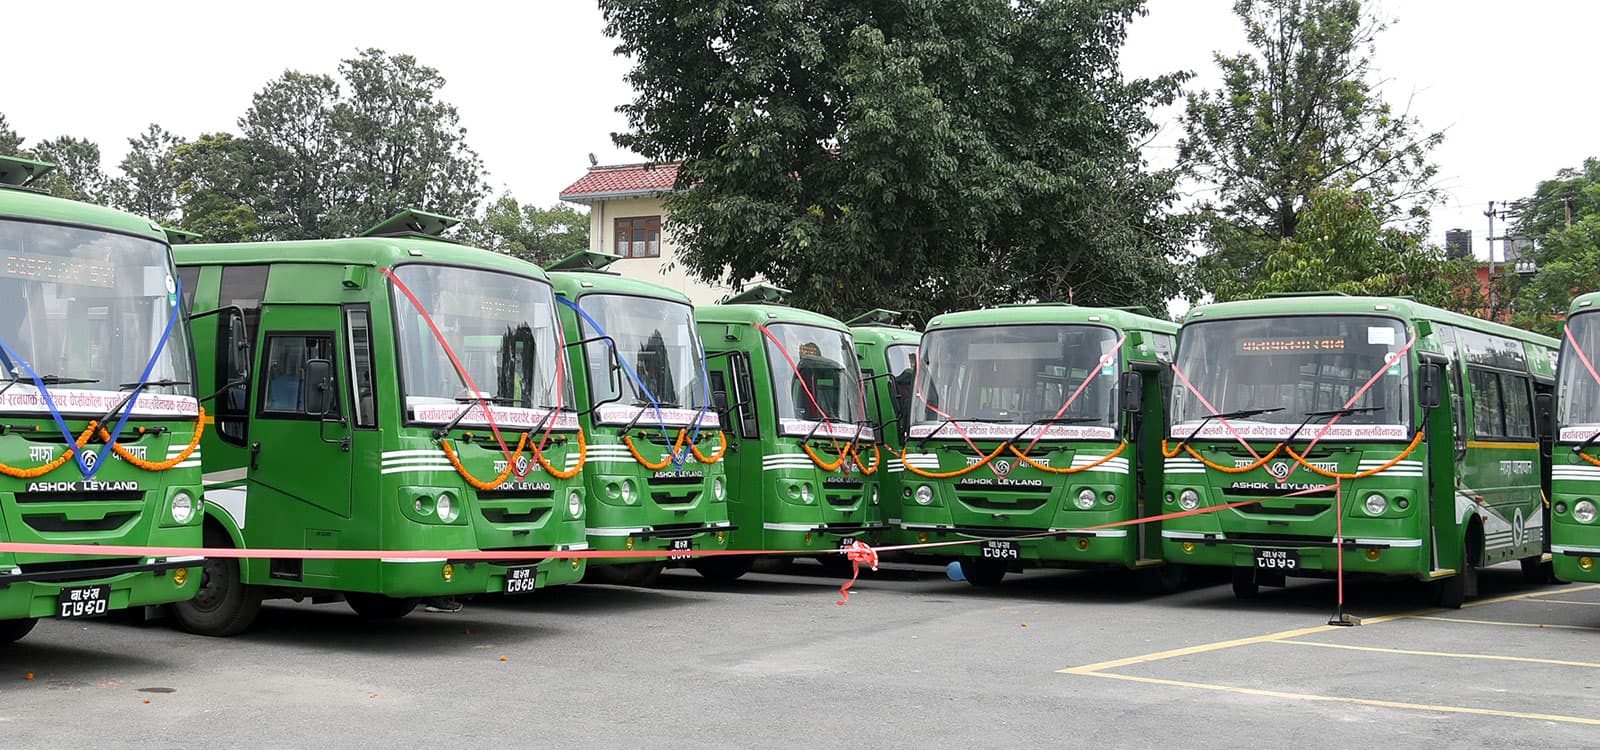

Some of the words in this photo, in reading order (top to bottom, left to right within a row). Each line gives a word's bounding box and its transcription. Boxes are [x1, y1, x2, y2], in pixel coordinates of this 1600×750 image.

[679, 470, 702, 478] LEYLAND
[28, 482, 76, 492] ASHOK
[83, 481, 138, 491] LEYLAND
[518, 482, 551, 490] LEYLAND
[997, 478, 1042, 486] LEYLAND
[983, 547, 1017, 559] ८७६१
[62, 600, 106, 617] ८७६०
